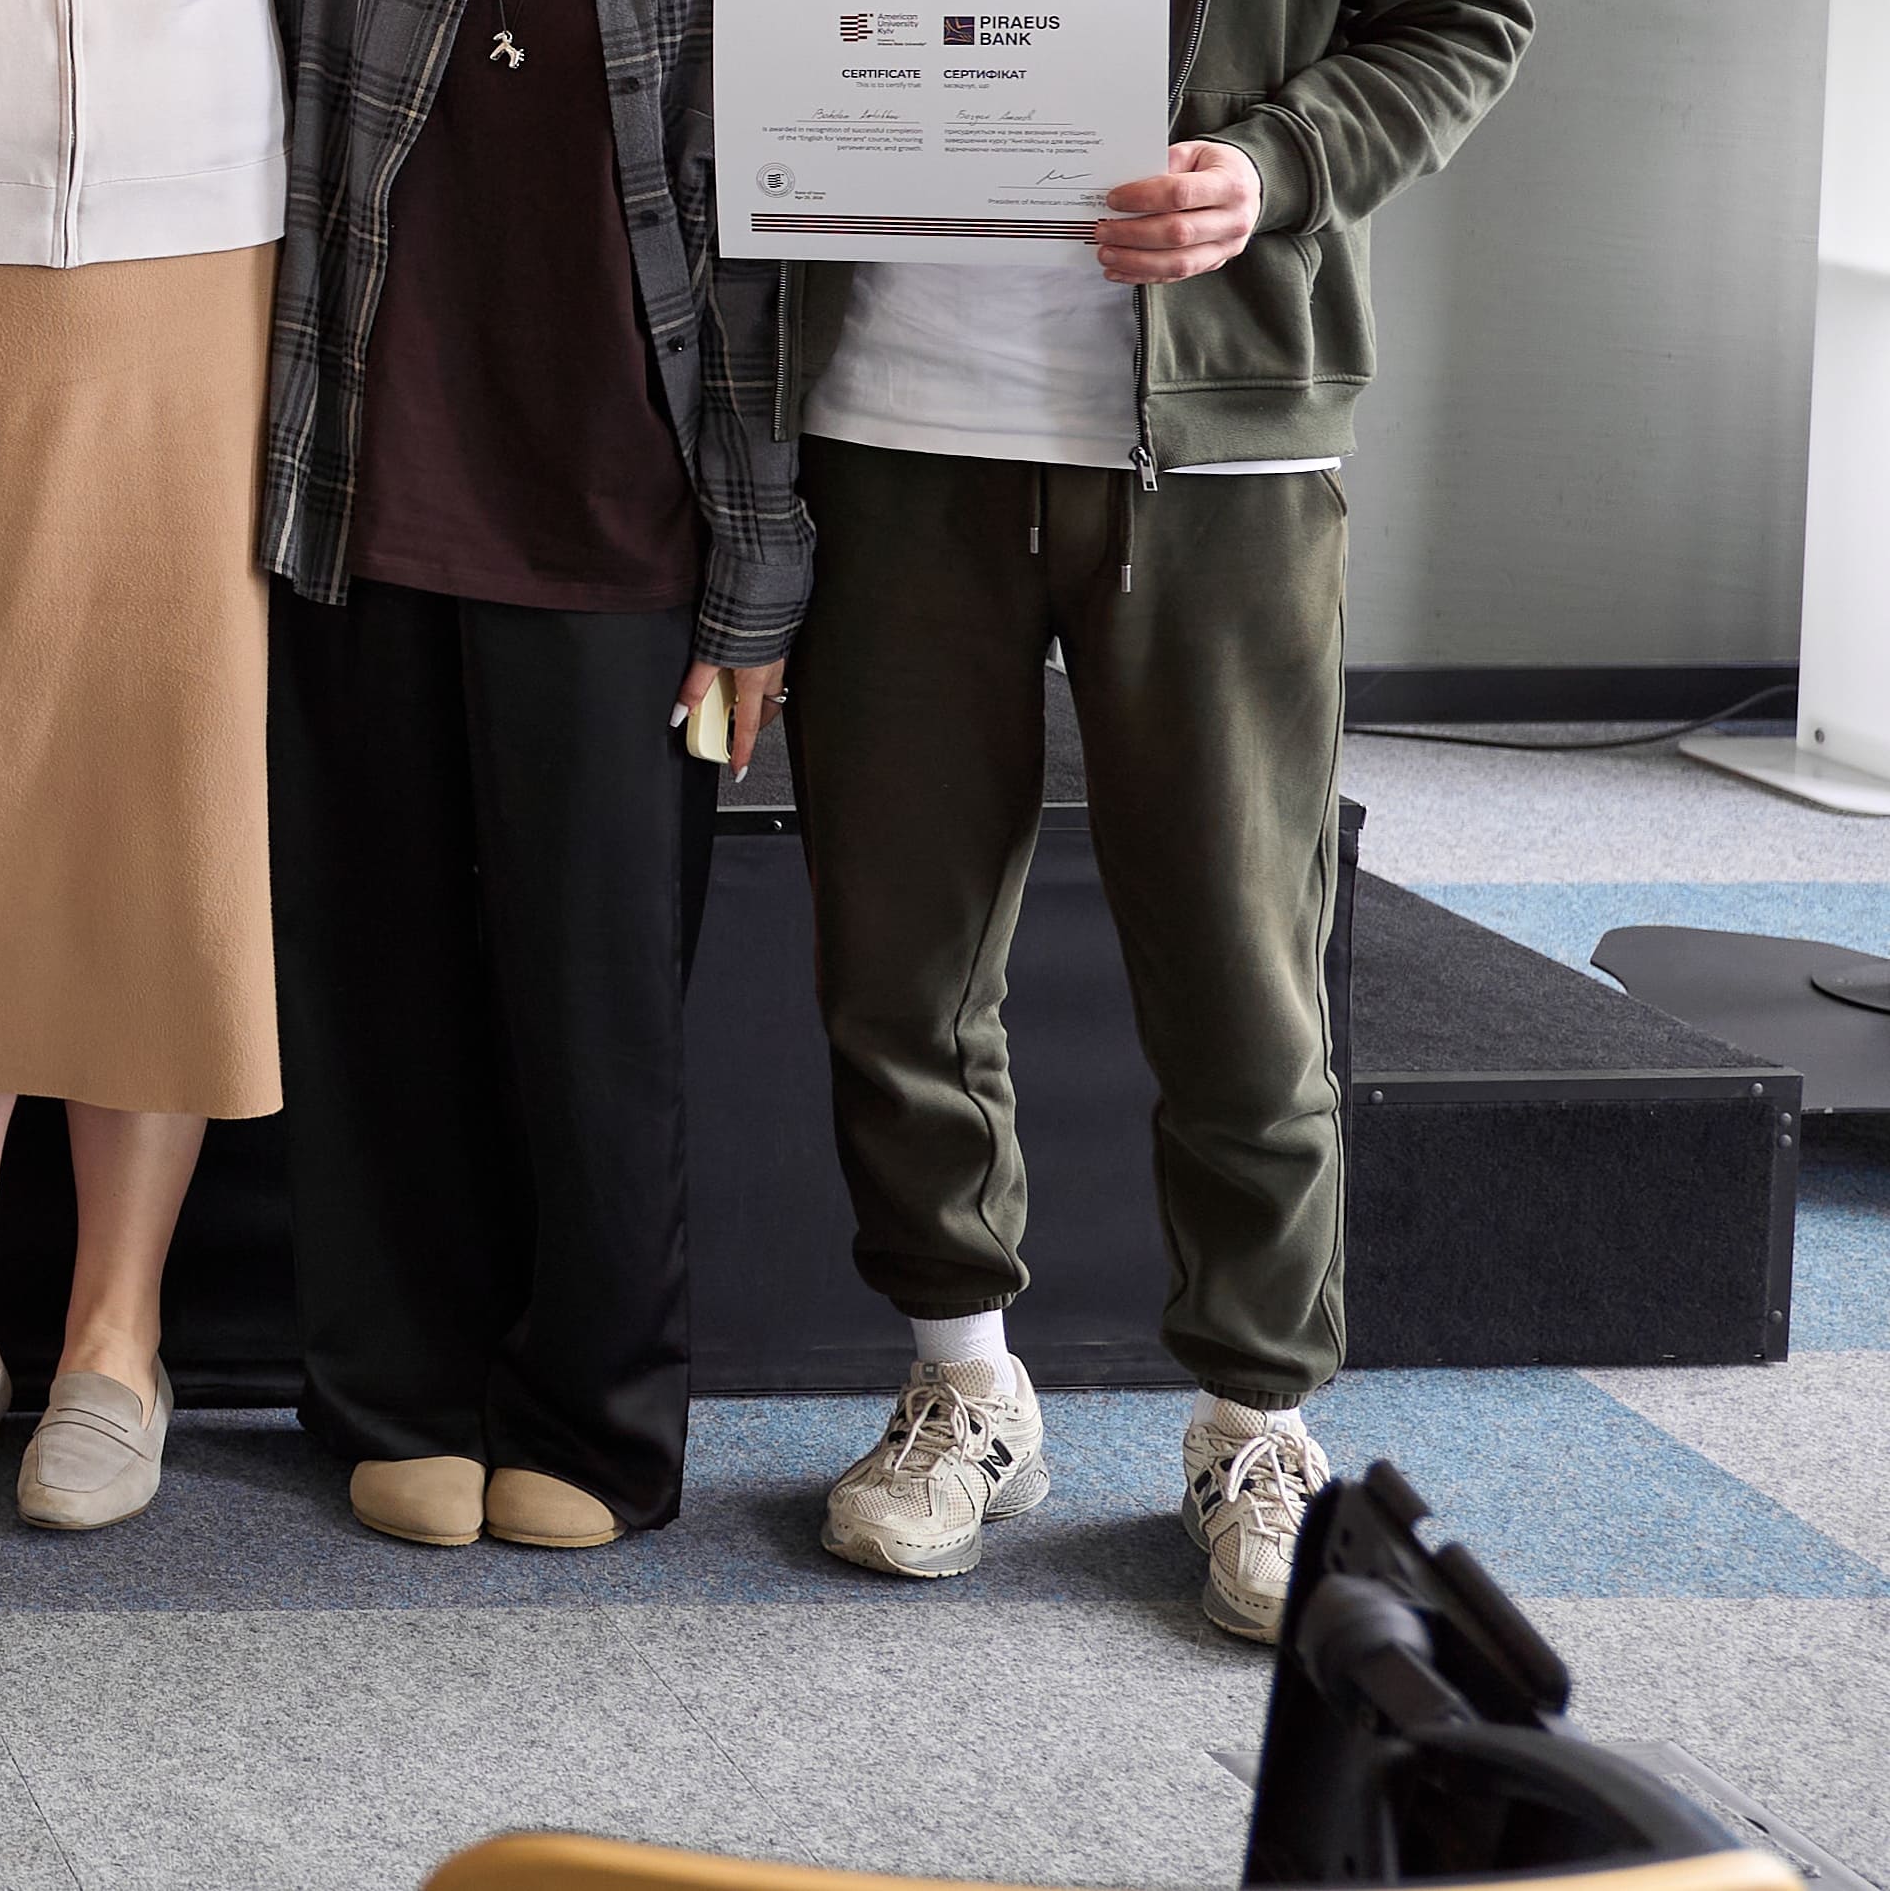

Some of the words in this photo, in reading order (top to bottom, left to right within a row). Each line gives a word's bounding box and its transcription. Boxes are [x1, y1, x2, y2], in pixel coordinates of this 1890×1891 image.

[980, 16, 1060, 30] PIRAEUS
[980, 33, 1032, 46] BANK
[841, 69, 921, 79] CERTIFICATE
[943, 70, 1028, 80] СЕРТИФІКАТ
